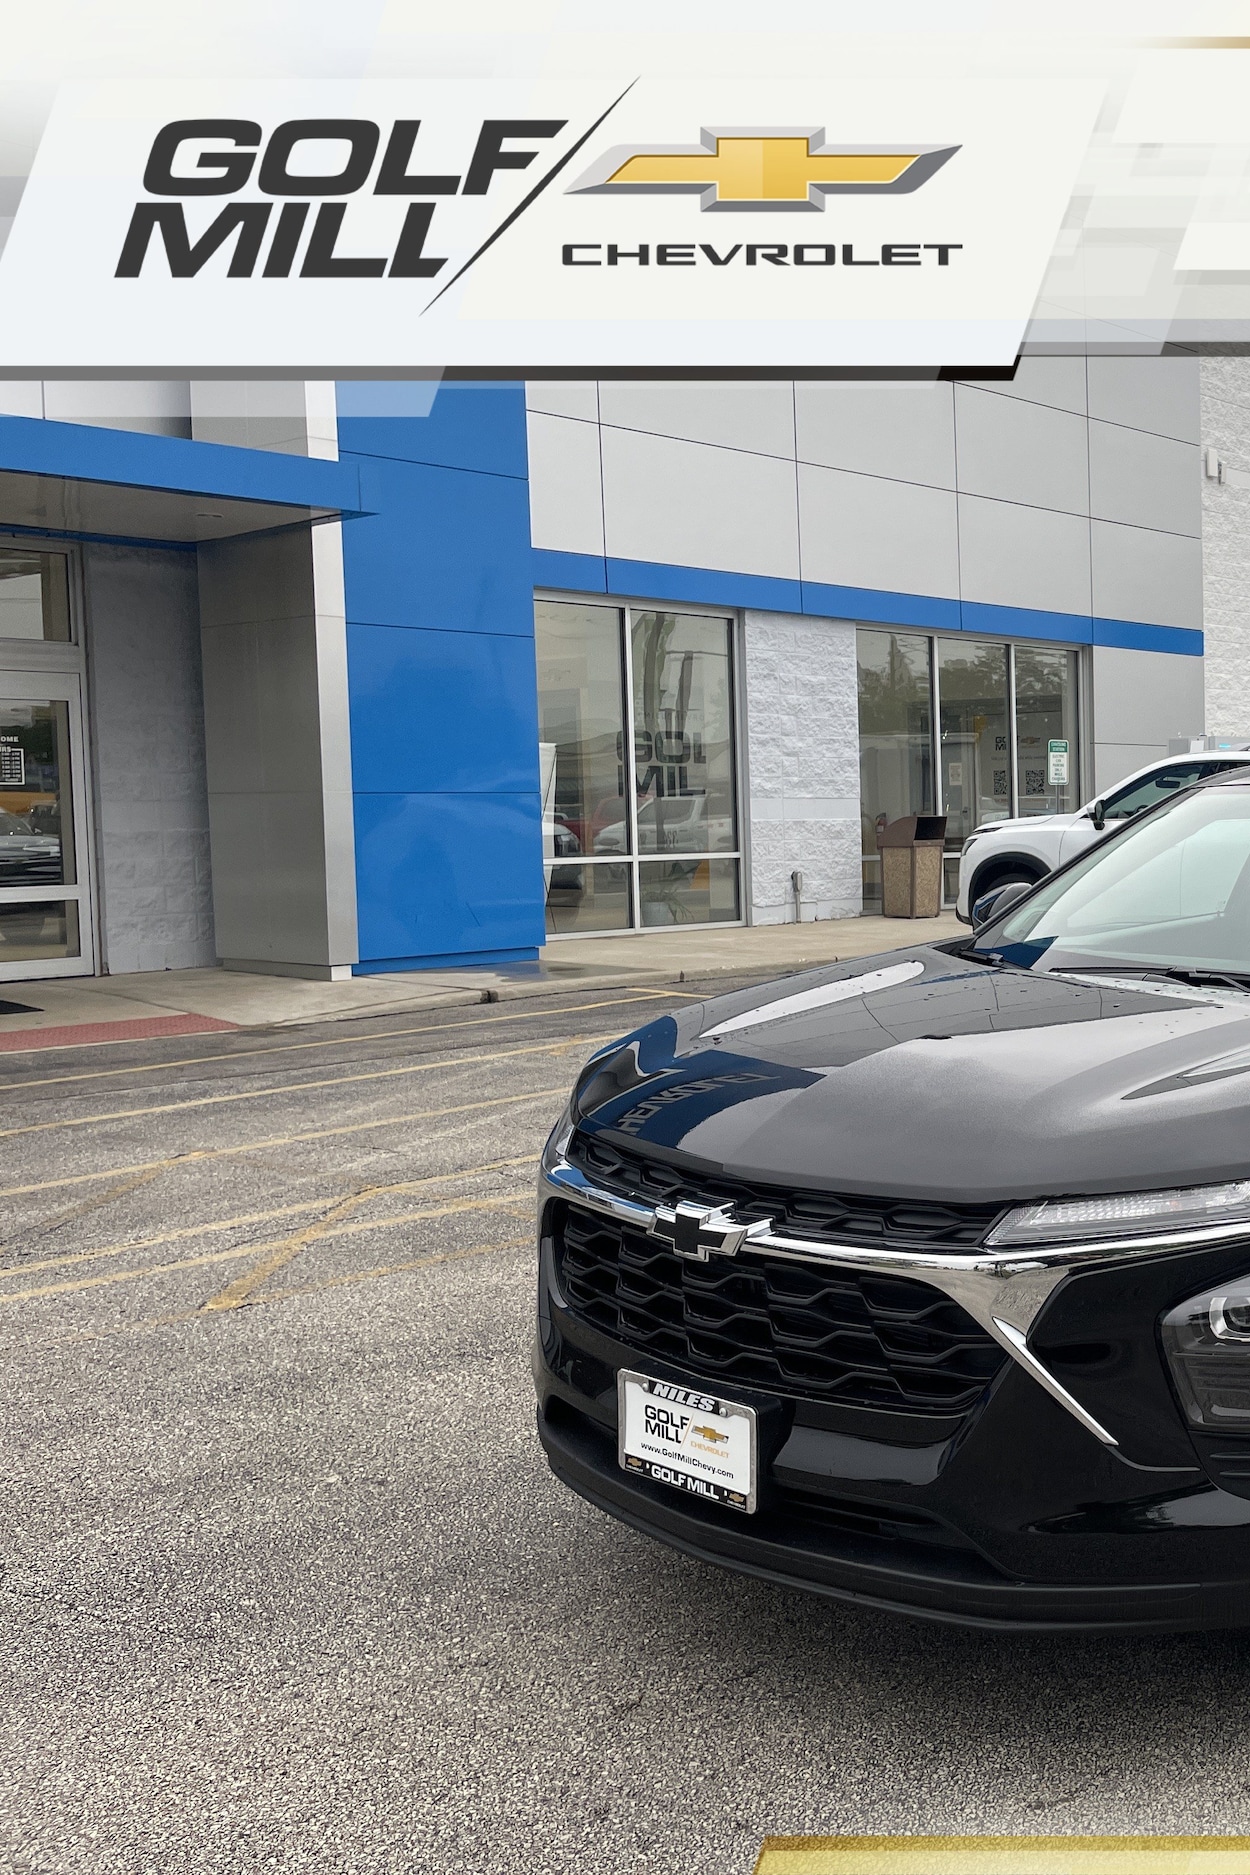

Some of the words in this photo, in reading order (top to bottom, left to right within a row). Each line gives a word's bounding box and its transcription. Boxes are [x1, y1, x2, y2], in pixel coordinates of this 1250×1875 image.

[652, 1382, 716, 1412] NILES
[644, 1404, 690, 1430] GOLF
[644, 1419, 682, 1444] MILL
[640, 1442, 734, 1479] www.GolfMillChevy.com
[690, 1440, 729, 1459] CHEVROLET
[651, 1464, 686, 1487] GOLF
[686, 1477, 720, 1500] MILL
